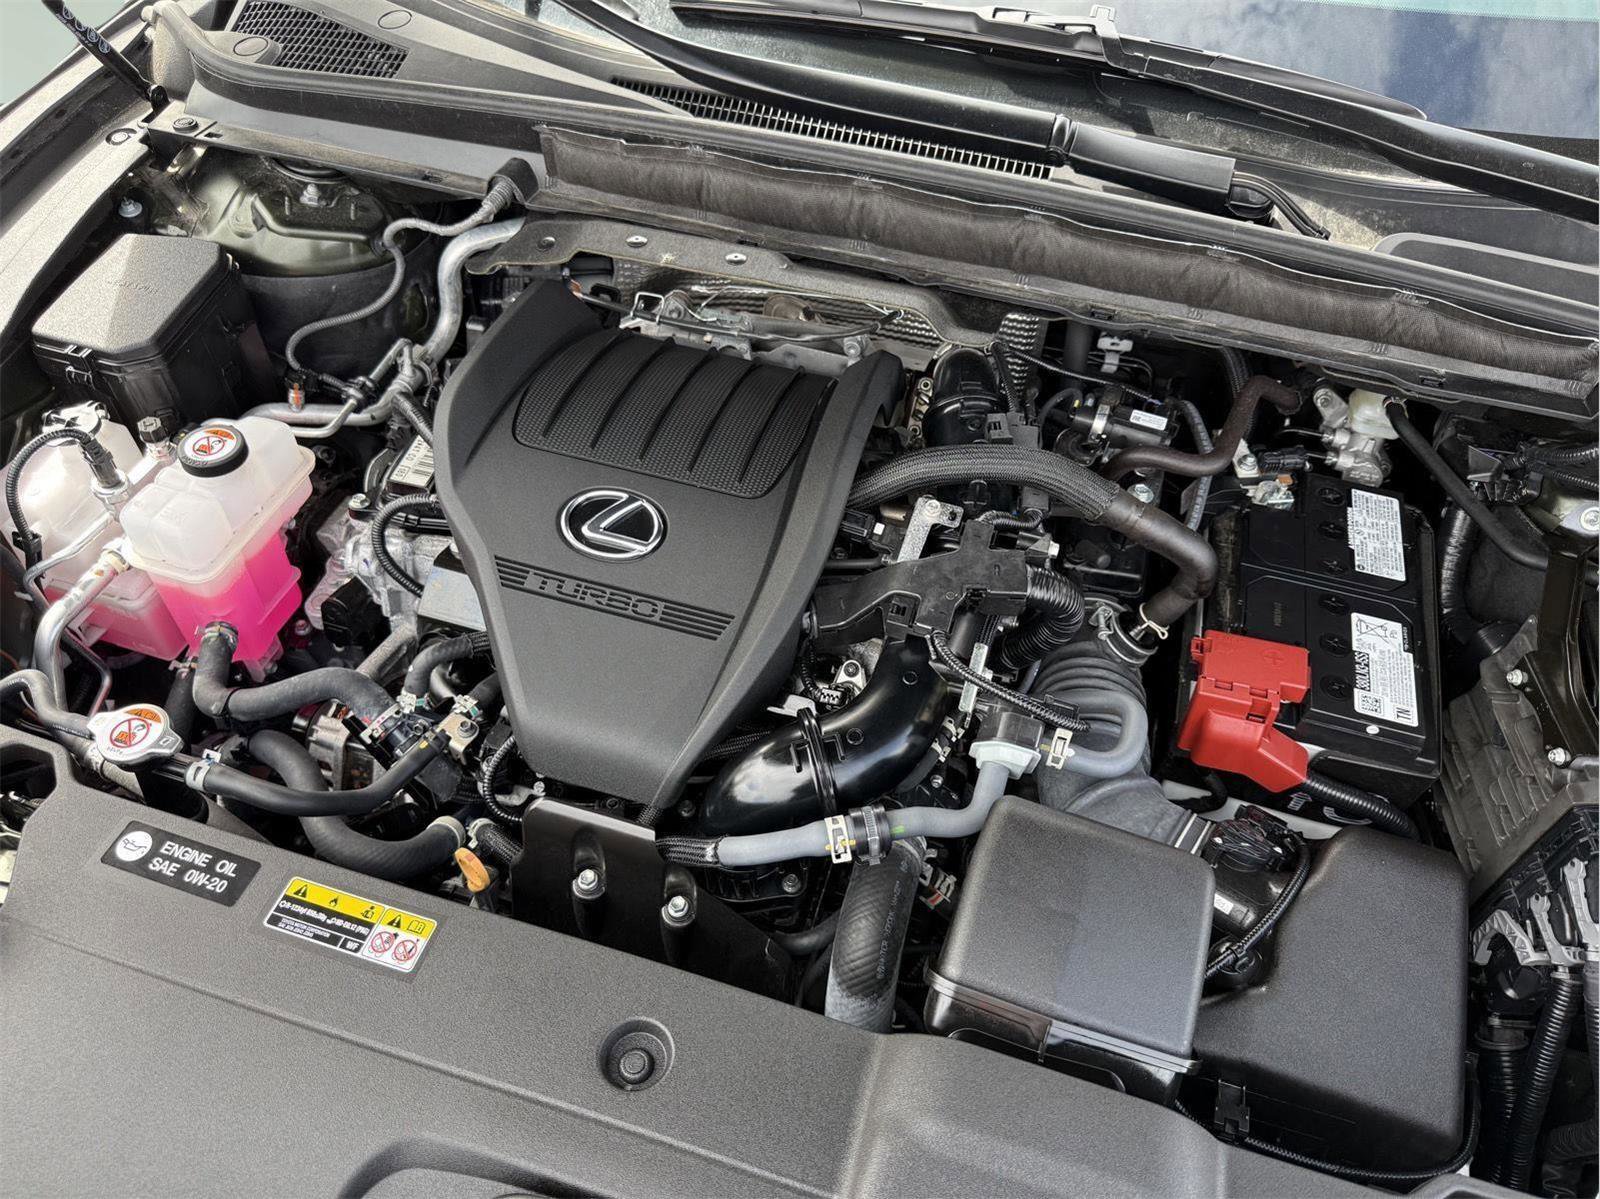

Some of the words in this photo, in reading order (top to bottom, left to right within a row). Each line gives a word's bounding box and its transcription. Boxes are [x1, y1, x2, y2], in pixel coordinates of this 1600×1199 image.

[532, 572, 661, 618] TURBO
[148, 856, 181, 877] SAE
[183, 869, 228, 893] 0W-20
[159, 840, 213, 867] ENGINE
[214, 859, 238, 878] OIL
